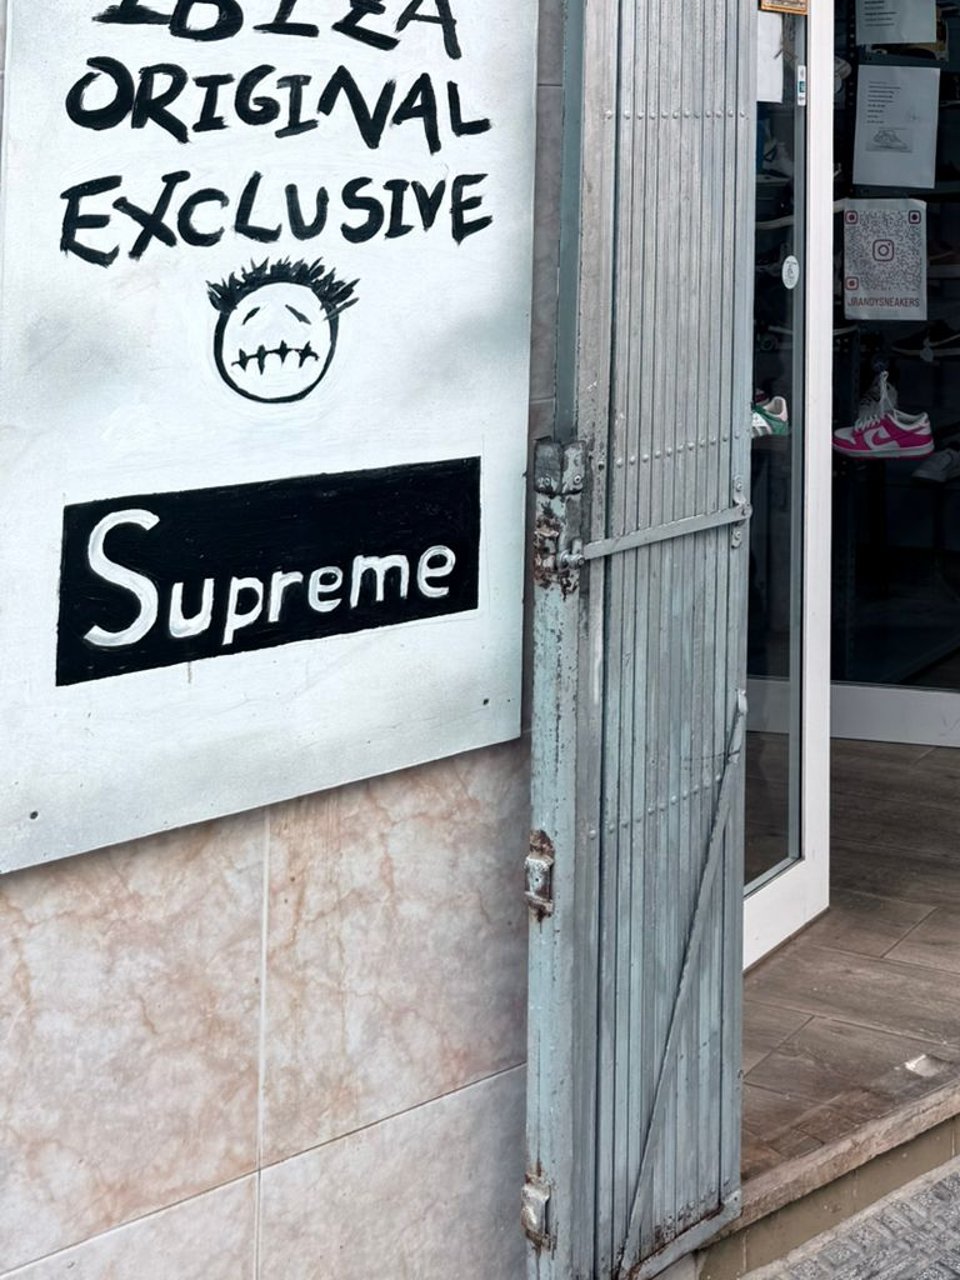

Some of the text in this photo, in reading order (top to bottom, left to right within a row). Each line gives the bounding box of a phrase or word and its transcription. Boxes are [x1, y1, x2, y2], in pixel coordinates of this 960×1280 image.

[65, 56, 493, 155] ORIGINAL
[60, 170, 493, 267] EXCLUSIVE
[83, 508, 457, 647] Supreme
